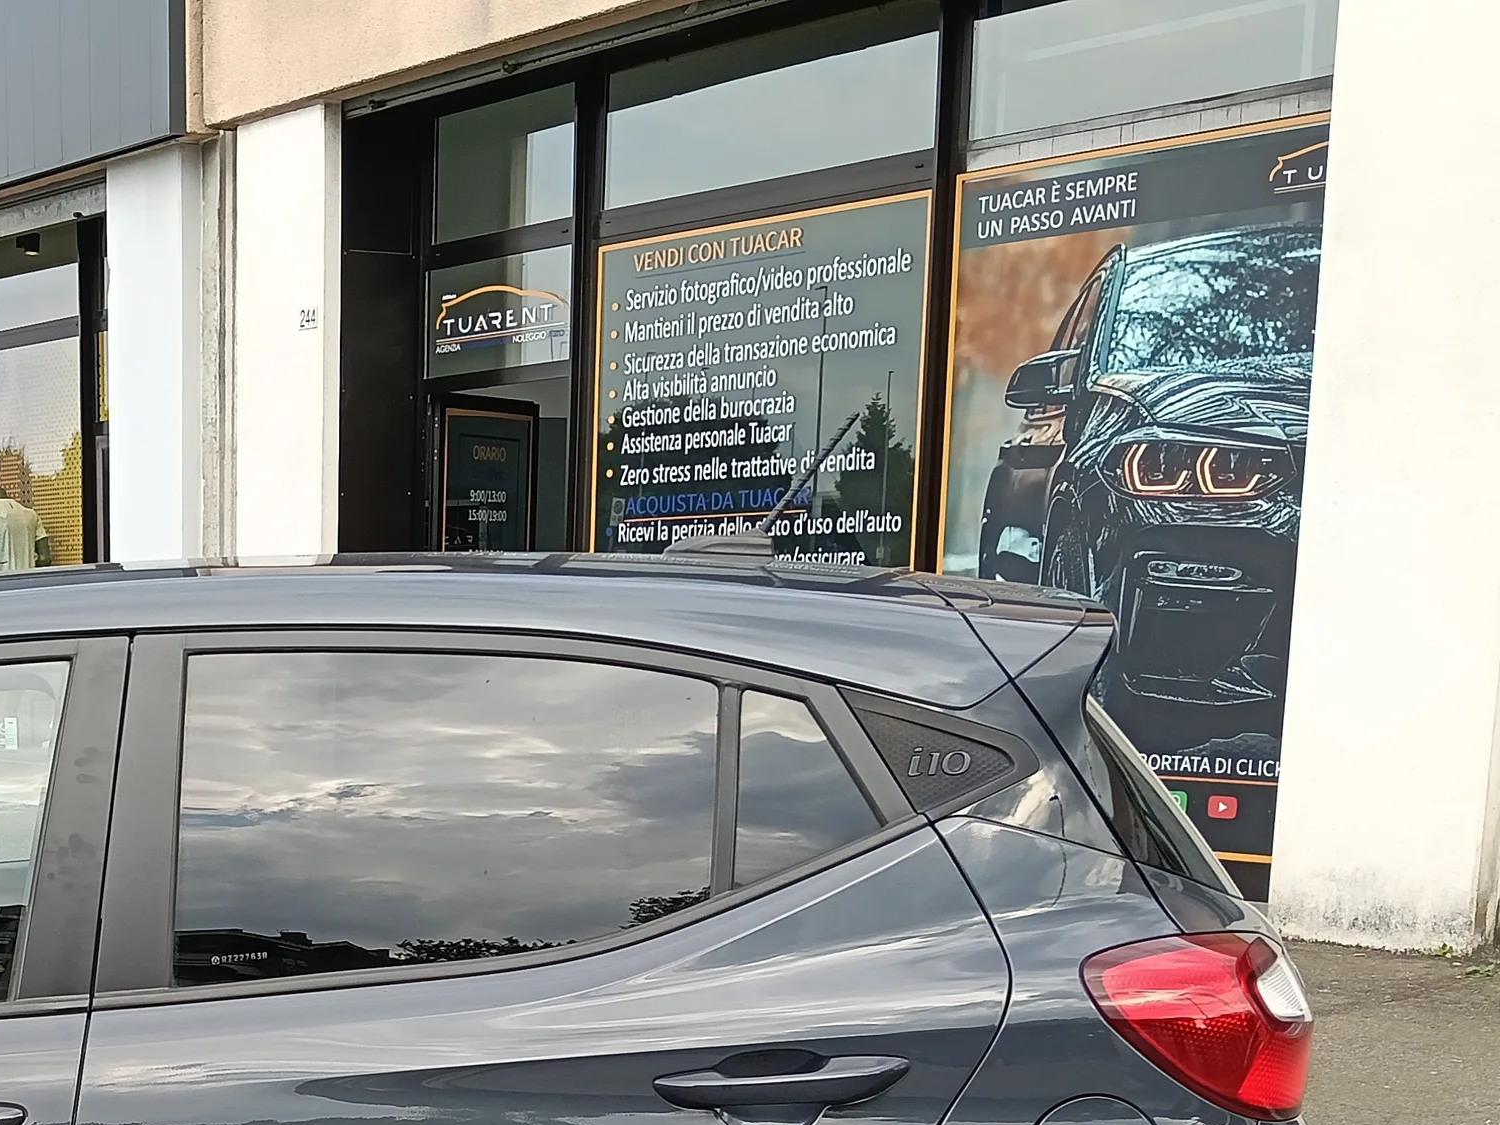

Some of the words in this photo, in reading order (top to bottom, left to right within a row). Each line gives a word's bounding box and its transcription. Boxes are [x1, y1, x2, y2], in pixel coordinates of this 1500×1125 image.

[978, 186, 1046, 214] TUACAR
[1050, 180, 1059, 203] È
[1065, 172, 1138, 202] SEMPRE
[977, 218, 1002, 240] UN
[1009, 208, 1064, 234] PASSO
[1070, 198, 1137, 226] AVANTI
[633, 246, 684, 272] VENDI
[687, 239, 725, 264] CON
[729, 227, 804, 257] TUACAR
[625, 287, 678, 312] Servizio
[680, 265, 803, 304] fotografico/video
[806, 247, 912, 290] professionale
[300, 309, 316, 328] 244
[443, 304, 553, 335] TUARENT
[624, 317, 684, 343] Mantieni
[686, 312, 695, 335] il
[699, 309, 744, 339] prezzo
[748, 304, 762, 327] di
[764, 296, 819, 324] vendita
[823, 292, 854, 315] alto
[512, 330, 547, 343] NOLEGGIO
[623, 351, 684, 375] Sicurezza
[688, 344, 720, 367] della
[724, 334, 808, 364] transazione
[812, 323, 896, 354] economica
[623, 378, 649, 401] Alta
[651, 366, 707, 397] visibilità
[710, 366, 777, 392] annuncio
[621, 404, 681, 429] Gestione
[683, 399, 717, 424] della
[720, 392, 795, 420] burocrazia
[472, 445, 507, 462] ORARIO
[621, 433, 682, 455] Assistenza
[685, 424, 747, 455] personale
[748, 422, 793, 445] Tuacar
[619, 464, 650, 486] Zero
[652, 461, 690, 484] stress
[693, 458, 728, 482] nelle
[730, 452, 796, 479] trattative
[800, 449, 815, 473] di
[819, 446, 875, 473] vendita
[469, 489, 507, 505] 9:00/13:00
[624, 493, 700, 516] ACQUISTA
[710, 490, 734, 510] DA
[468, 509, 507, 523] 15:00/19:00
[617, 521, 655, 543] Ricevi
[657, 520, 670, 540] la
[671, 517, 715, 545] perizia
[718, 512, 752, 536] dello
[794, 514, 833, 537] d'uso
[836, 511, 901, 534] dell'auto
[908, 746, 971, 777] i10
[1215, 758, 1232, 774] DI
